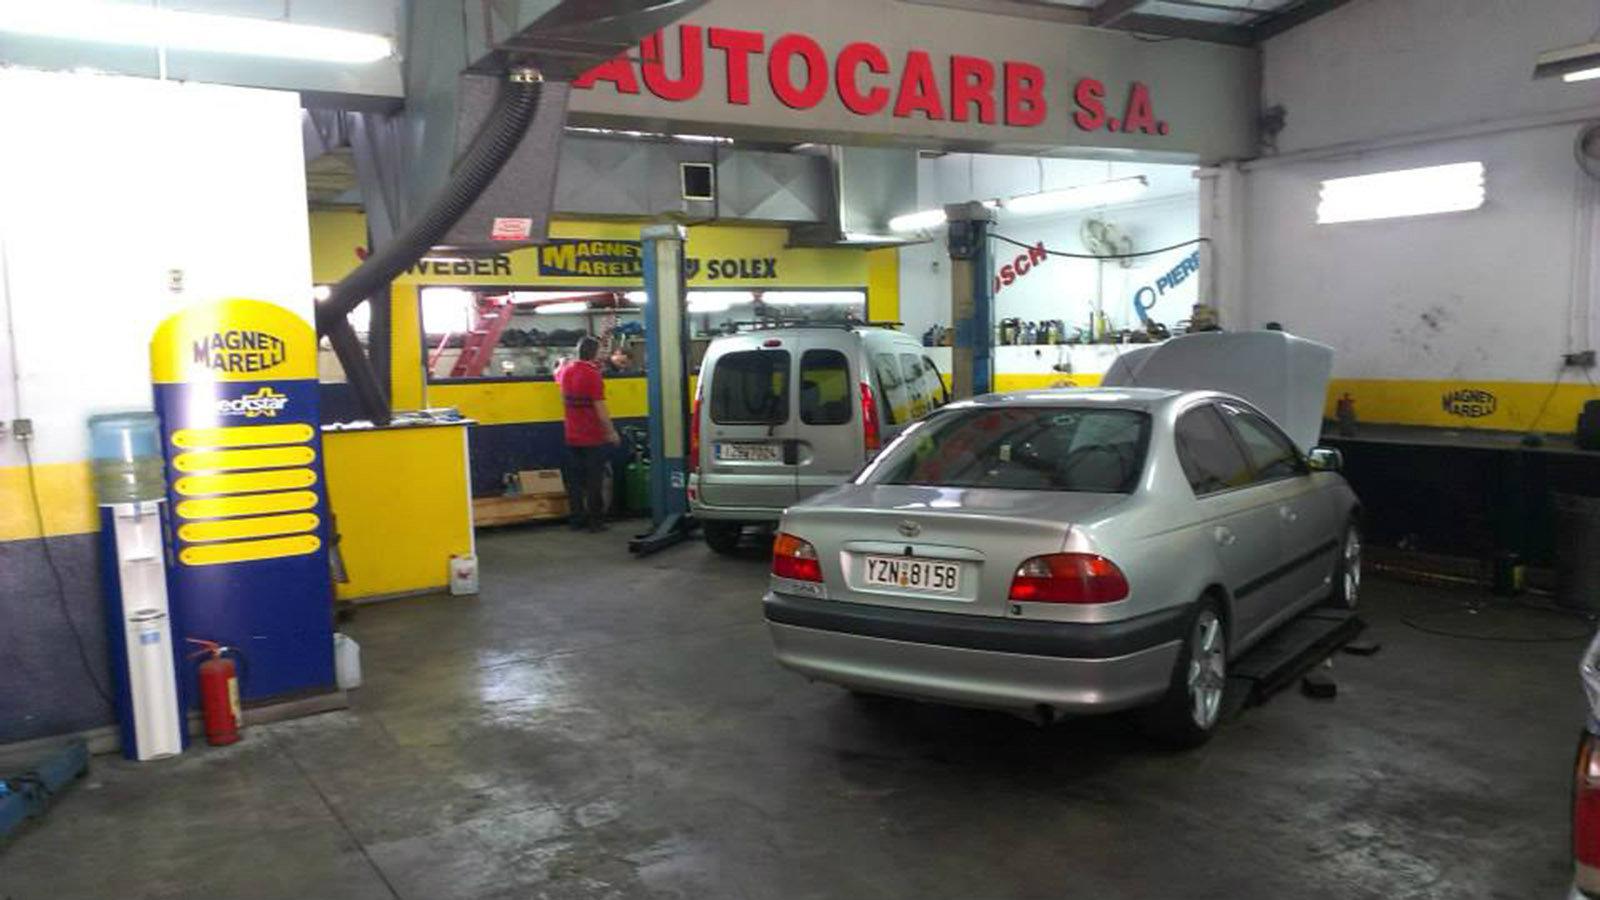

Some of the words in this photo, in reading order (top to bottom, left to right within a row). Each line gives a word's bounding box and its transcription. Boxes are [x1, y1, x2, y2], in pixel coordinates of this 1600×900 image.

[572, 25, 1047, 127] AUTOCARB
[1073, 79, 1169, 136] S.A.
[707, 258, 777, 279] SOLEX
[909, 561, 958, 589] 8158
